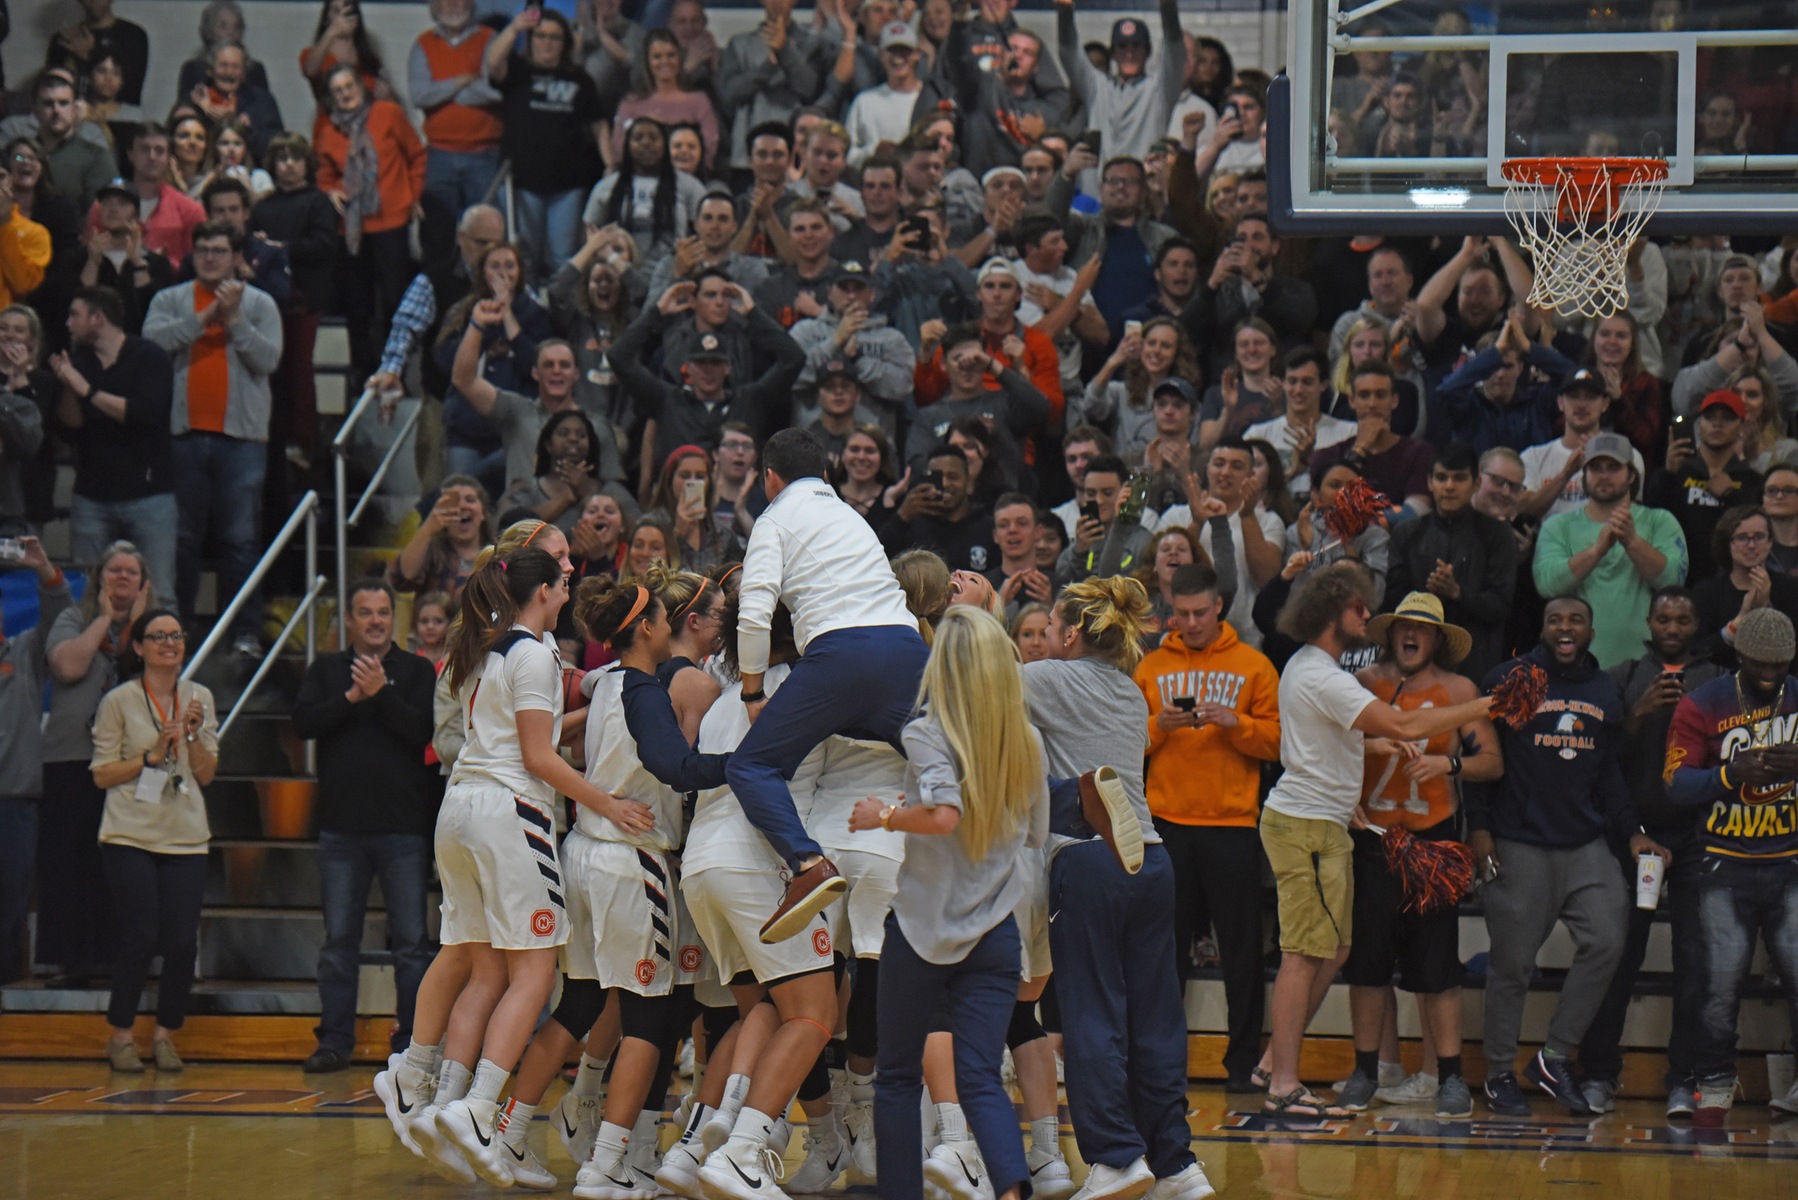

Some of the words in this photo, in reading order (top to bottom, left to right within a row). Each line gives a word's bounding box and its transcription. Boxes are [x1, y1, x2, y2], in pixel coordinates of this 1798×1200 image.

[1339, 645, 1380, 667] NEWMA
[1156, 670, 1246, 710] TENNESSEE
[1536, 699, 1604, 722] RSON-NEWMAN
[1717, 705, 1771, 733] CLEVEAND
[1534, 733, 1595, 750] FOOTBALL
